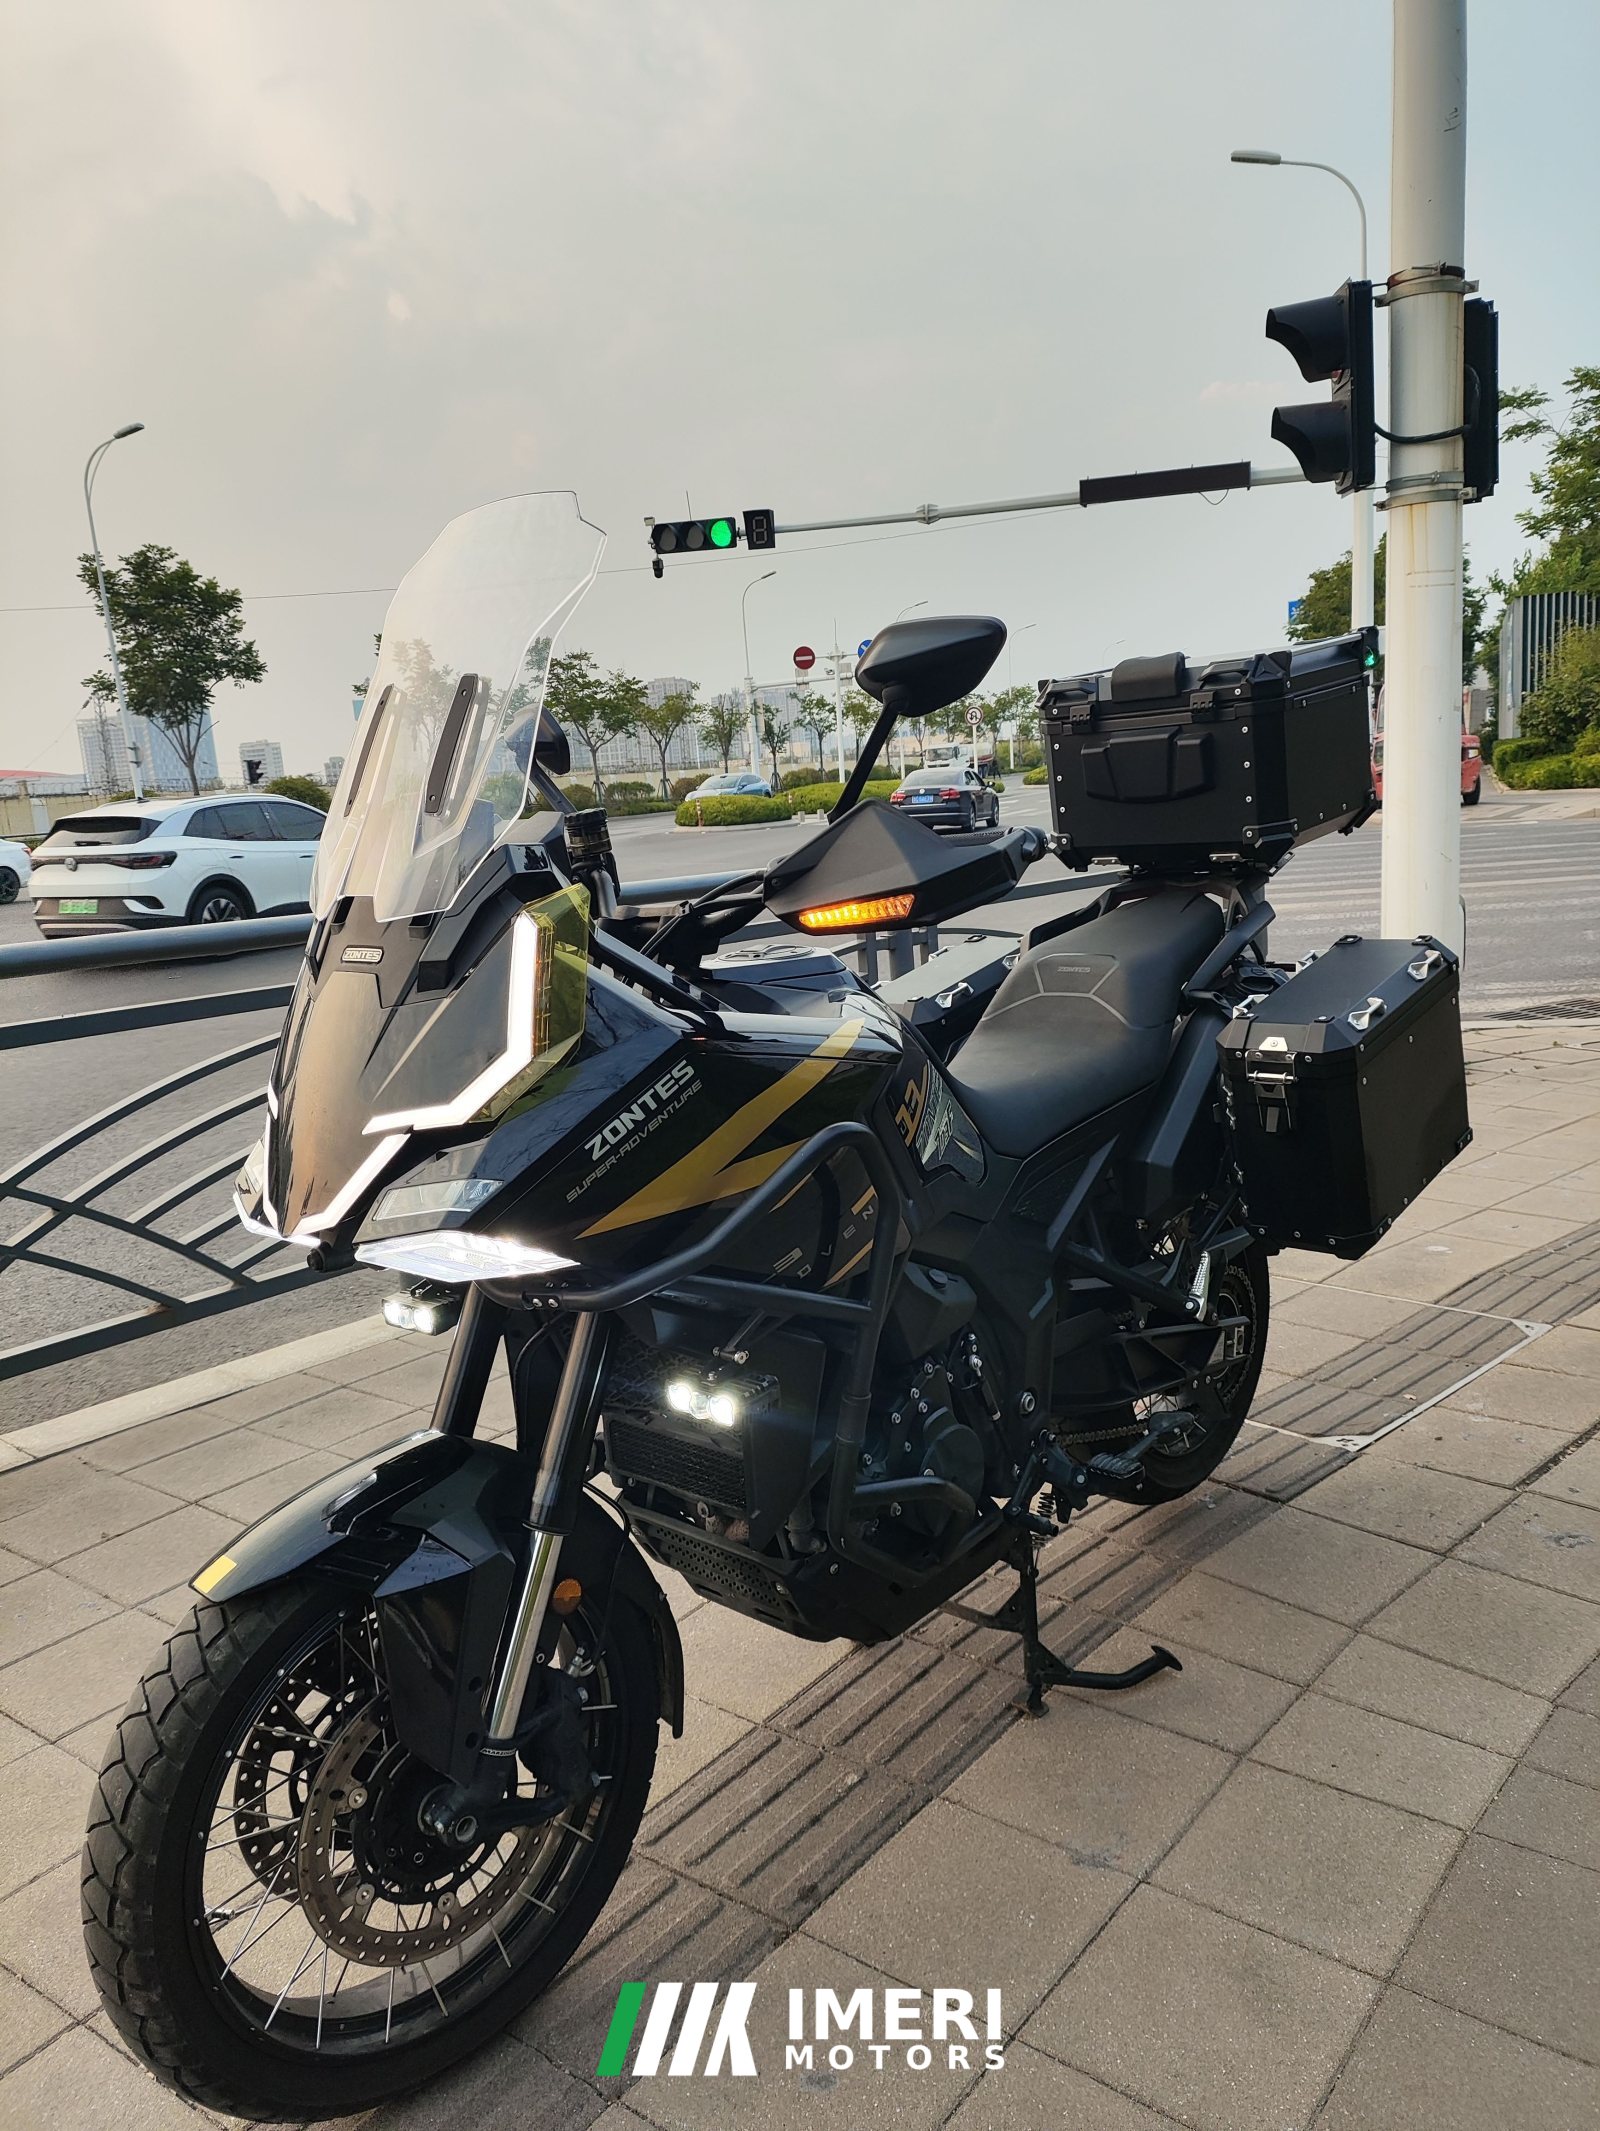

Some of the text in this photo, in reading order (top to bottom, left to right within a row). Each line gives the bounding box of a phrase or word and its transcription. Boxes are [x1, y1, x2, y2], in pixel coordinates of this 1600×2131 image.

[344, 950, 381, 960] ZONTES
[566, 1079, 702, 1203] SUPER-ADVENTURE
[584, 1060, 695, 1161] ZONTES
